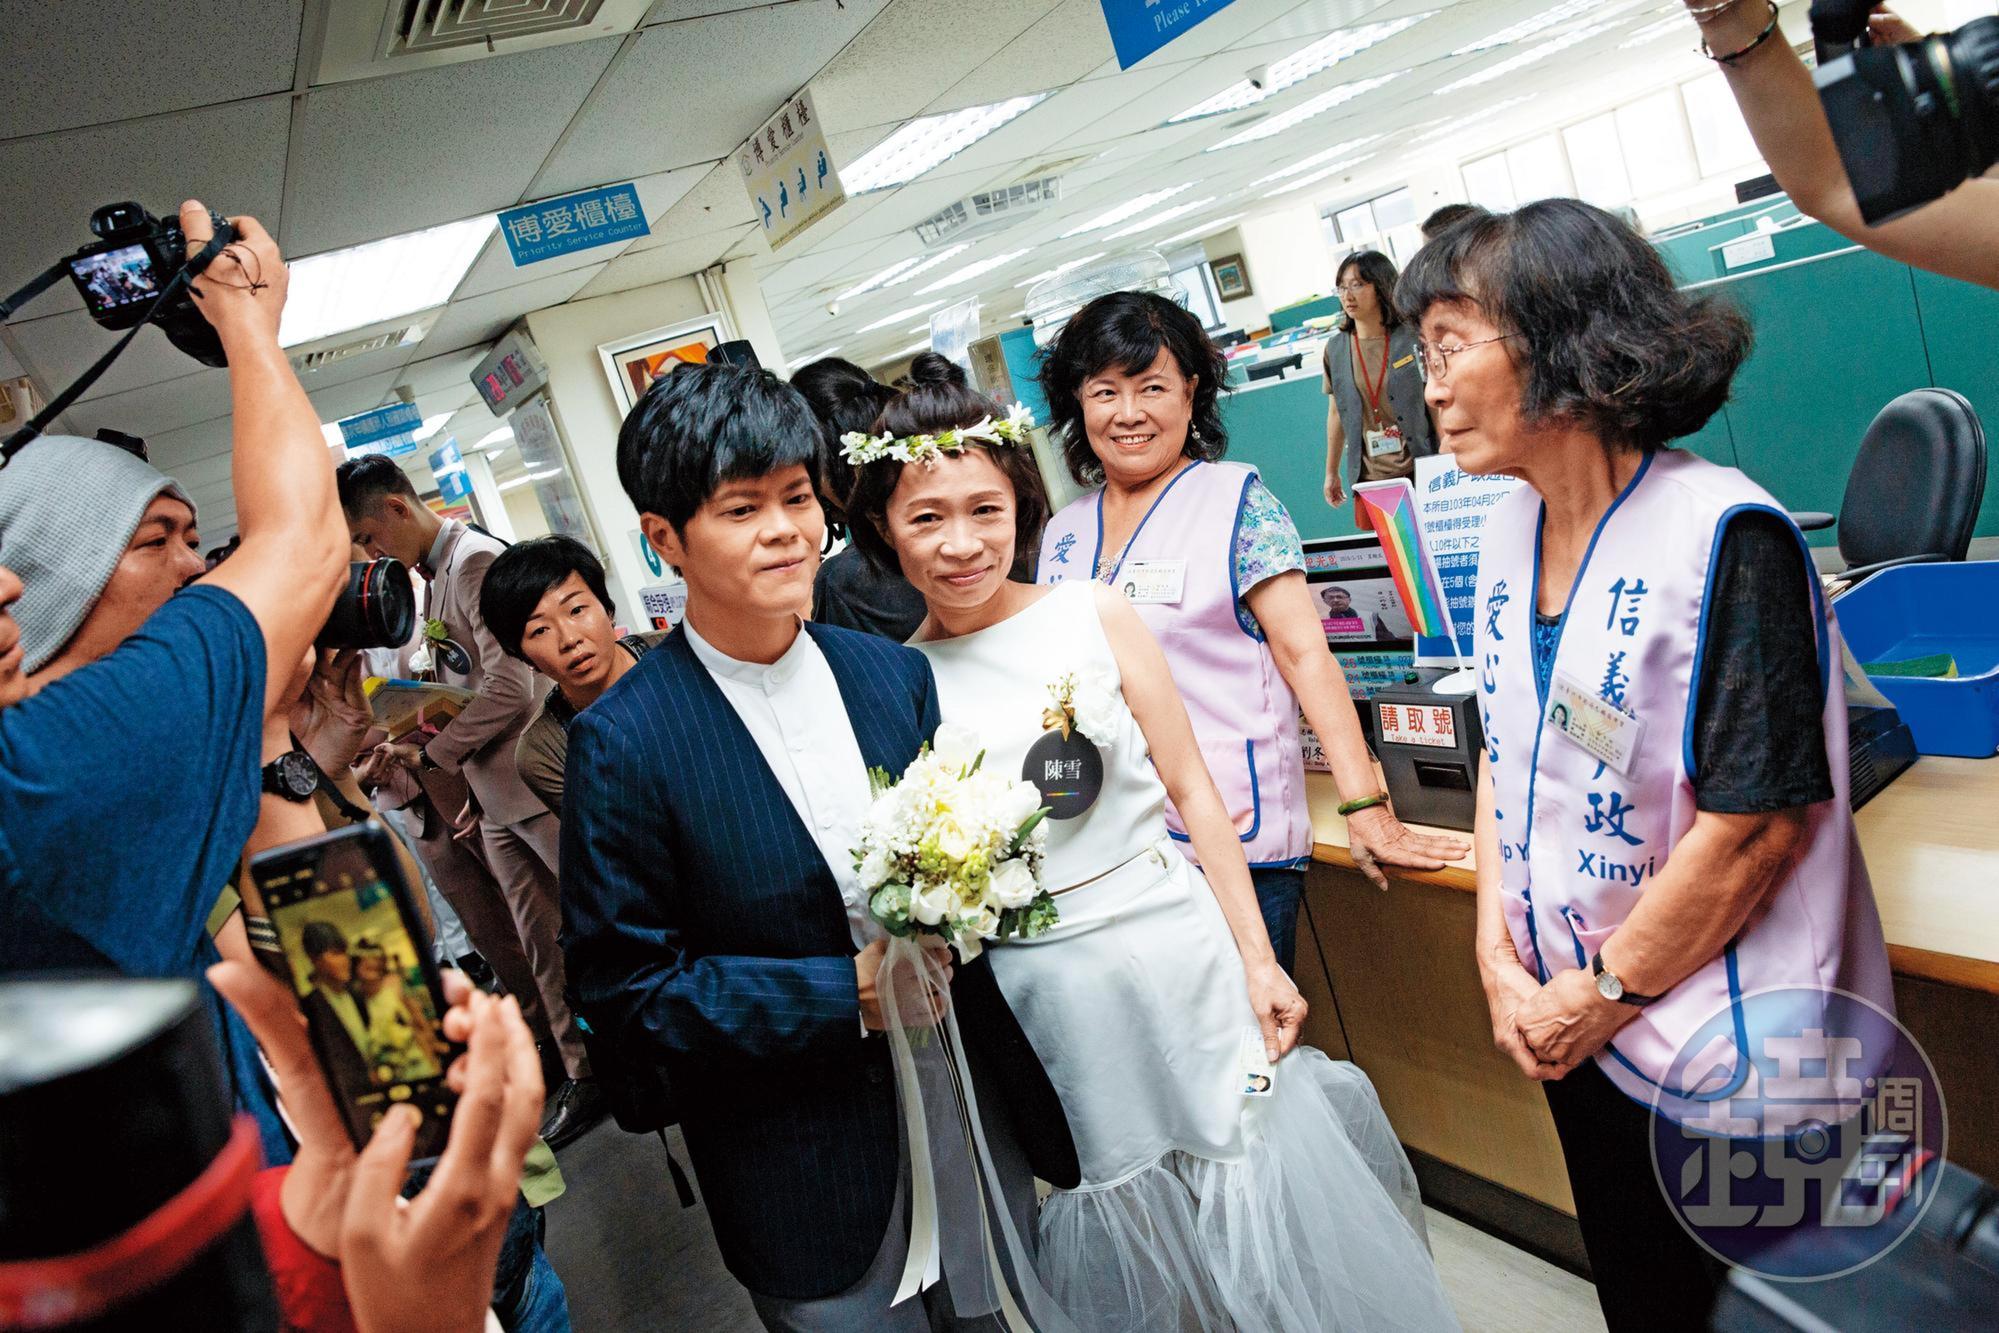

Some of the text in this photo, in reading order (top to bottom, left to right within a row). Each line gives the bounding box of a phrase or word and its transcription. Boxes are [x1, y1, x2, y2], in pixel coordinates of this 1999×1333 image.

[1154, 2, 1190, 32] Please
[518, 223, 643, 259] Priority Service Counter
[1453, 621, 1474, 636] 您的
[1381, 706, 1453, 734] 請取號
[1584, 577, 1649, 846] 信義政
[1391, 734, 1408, 742] Take
[1420, 737, 1446, 745] ticket
[1044, 759, 1082, 781] 陳雪
[1577, 849, 1655, 887] Xinyi
